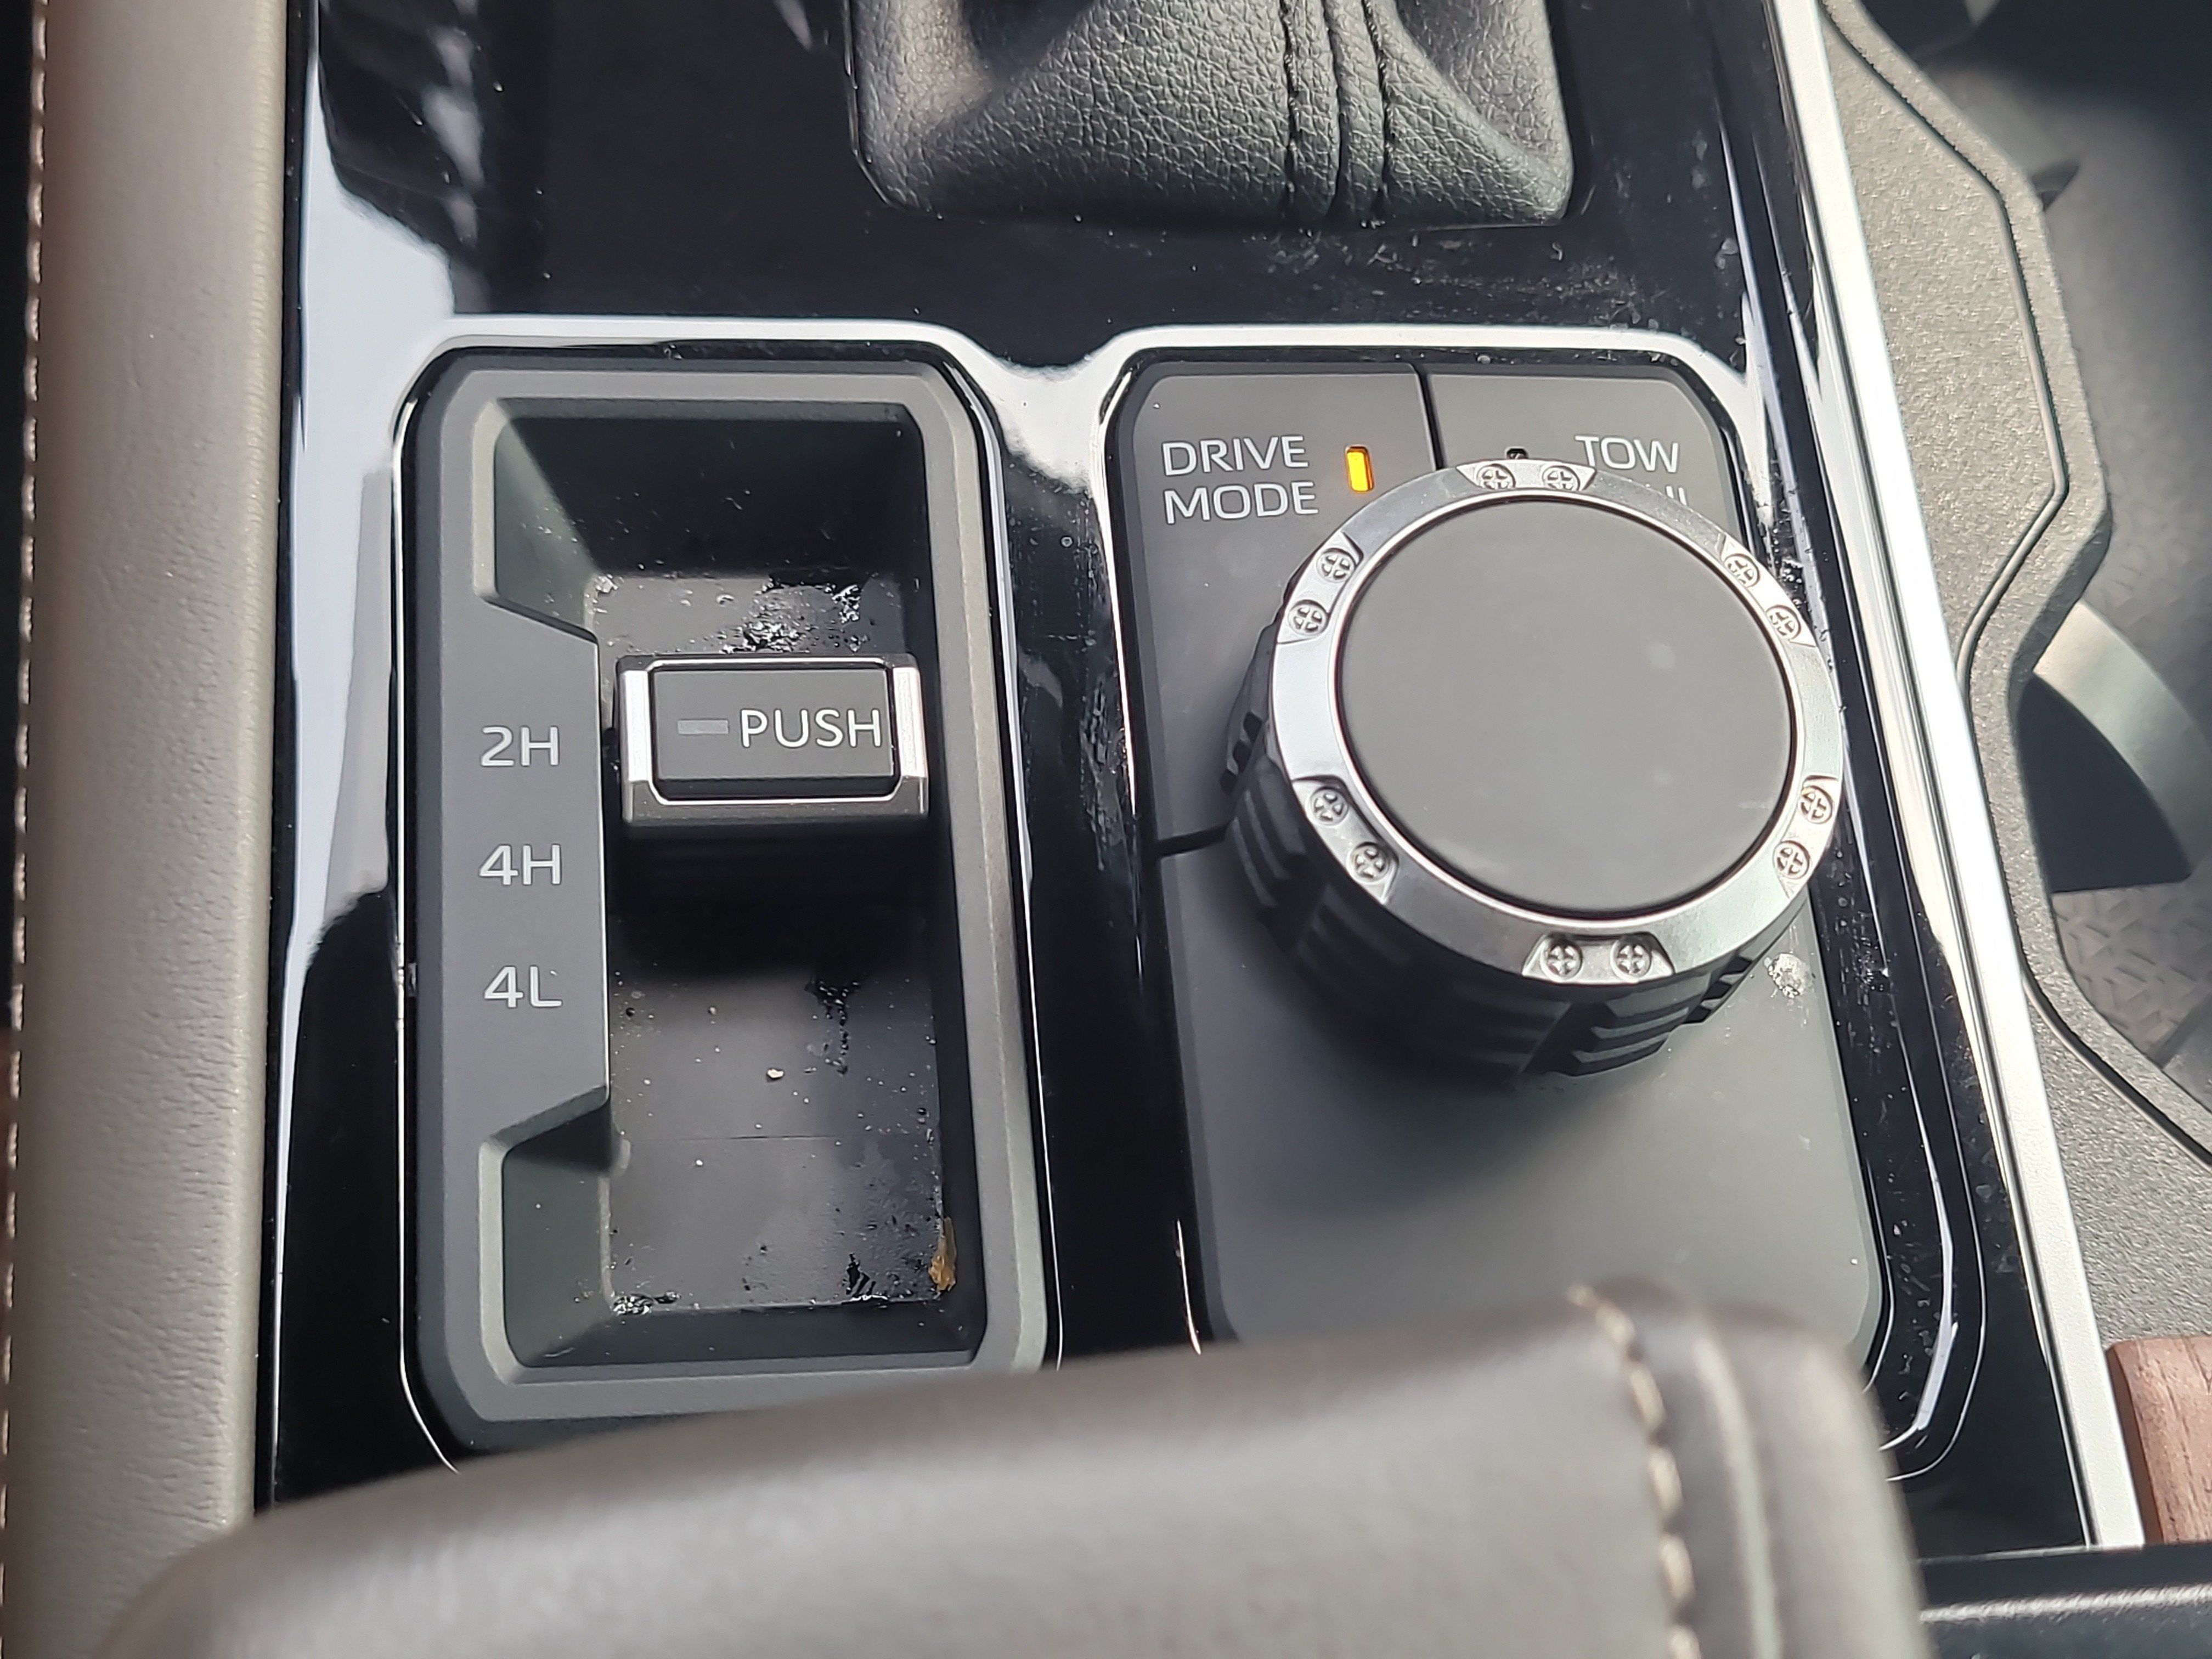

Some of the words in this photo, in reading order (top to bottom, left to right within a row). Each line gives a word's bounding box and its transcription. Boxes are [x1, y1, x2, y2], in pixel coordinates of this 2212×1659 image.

[1161, 435, 1309, 476] DRIVE
[1574, 435, 1680, 473] TOW
[1164, 481, 1318, 524] MODE
[481, 726, 560, 766] 2H
[740, 709, 882, 748] PUSH
[478, 844, 562, 885] 4H
[484, 966, 562, 1008] 4L
